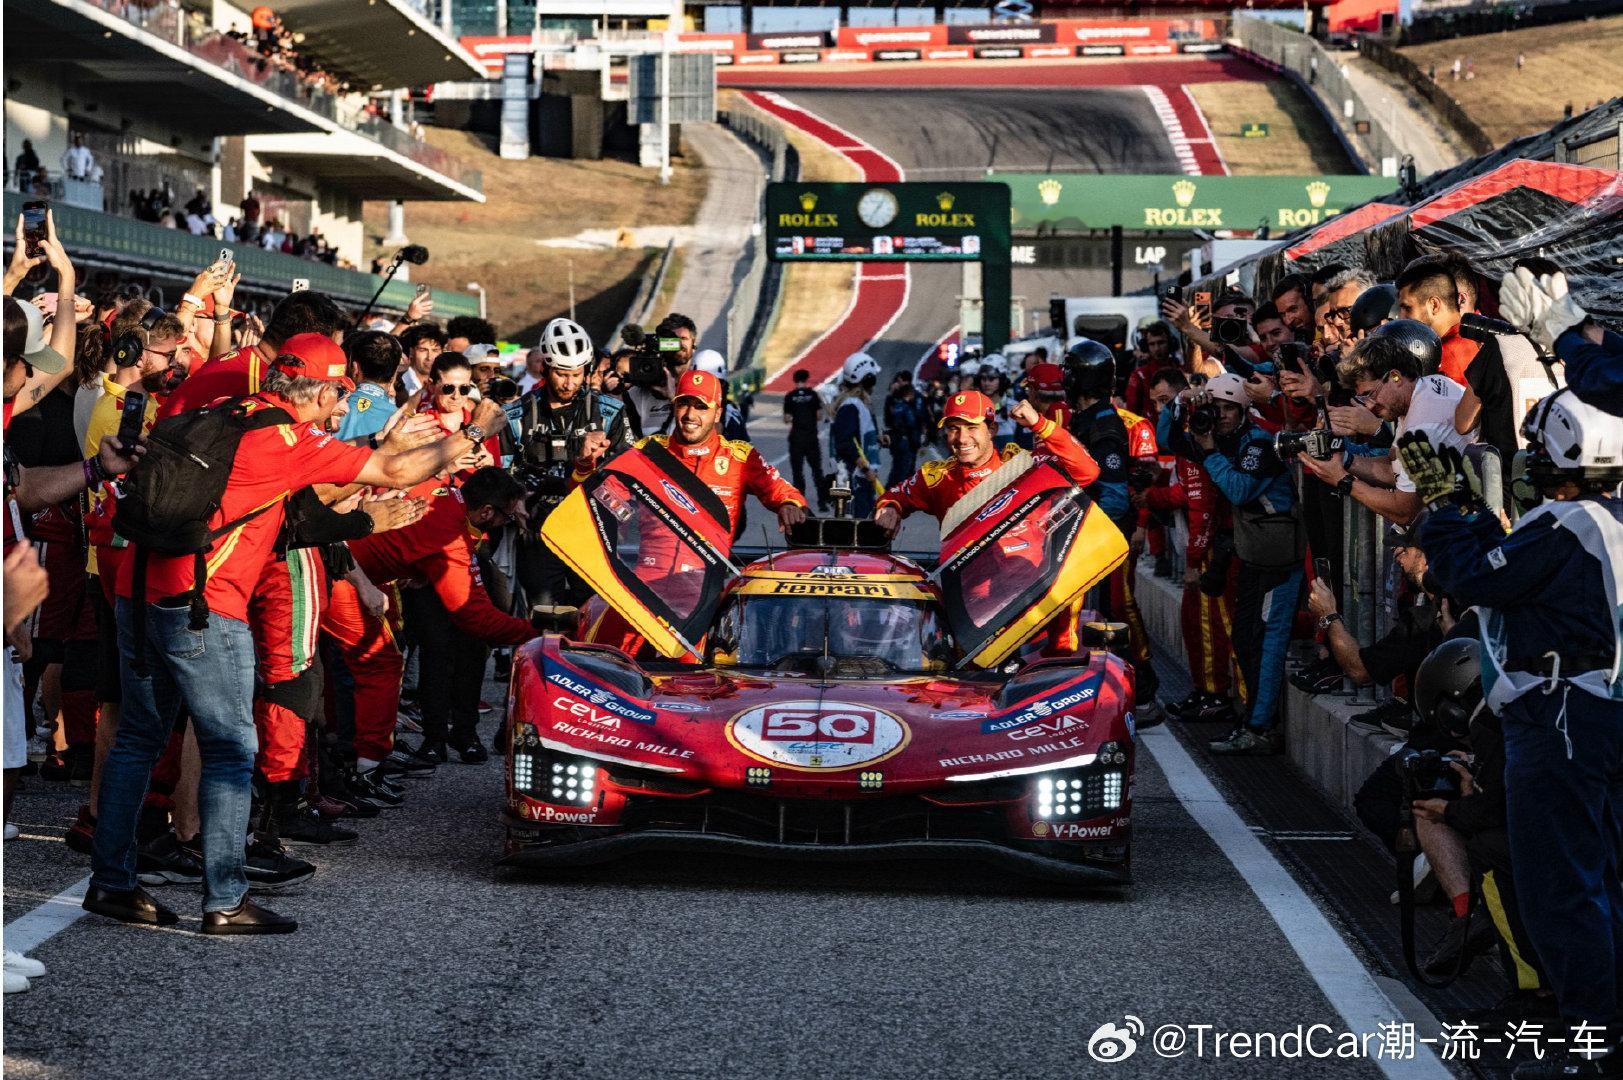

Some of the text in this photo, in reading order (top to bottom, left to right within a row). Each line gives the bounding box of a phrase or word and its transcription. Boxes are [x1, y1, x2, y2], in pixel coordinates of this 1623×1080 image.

[778, 213, 839, 227] ROLEX
[916, 213, 976, 227] ROLEX
[1144, 208, 1223, 226] ROLEX
[1278, 208, 1341, 226] ROL
[1010, 246, 1037, 264] ME
[1135, 247, 1167, 264] LAP
[770, 580, 893, 597] Ferrari
[547, 673, 652, 721] ADLER GROUP
[990, 688, 1095, 731] ADLER GROUP
[766, 712, 870, 739] 50
[1048, 723, 1090, 738] LOGISTICS
[552, 721, 695, 759] RICHARD MILLE
[938, 737, 1085, 768] RICHARD MILLE
[531, 806, 597, 823] V-Power
[1051, 824, 1113, 838] V-Power
